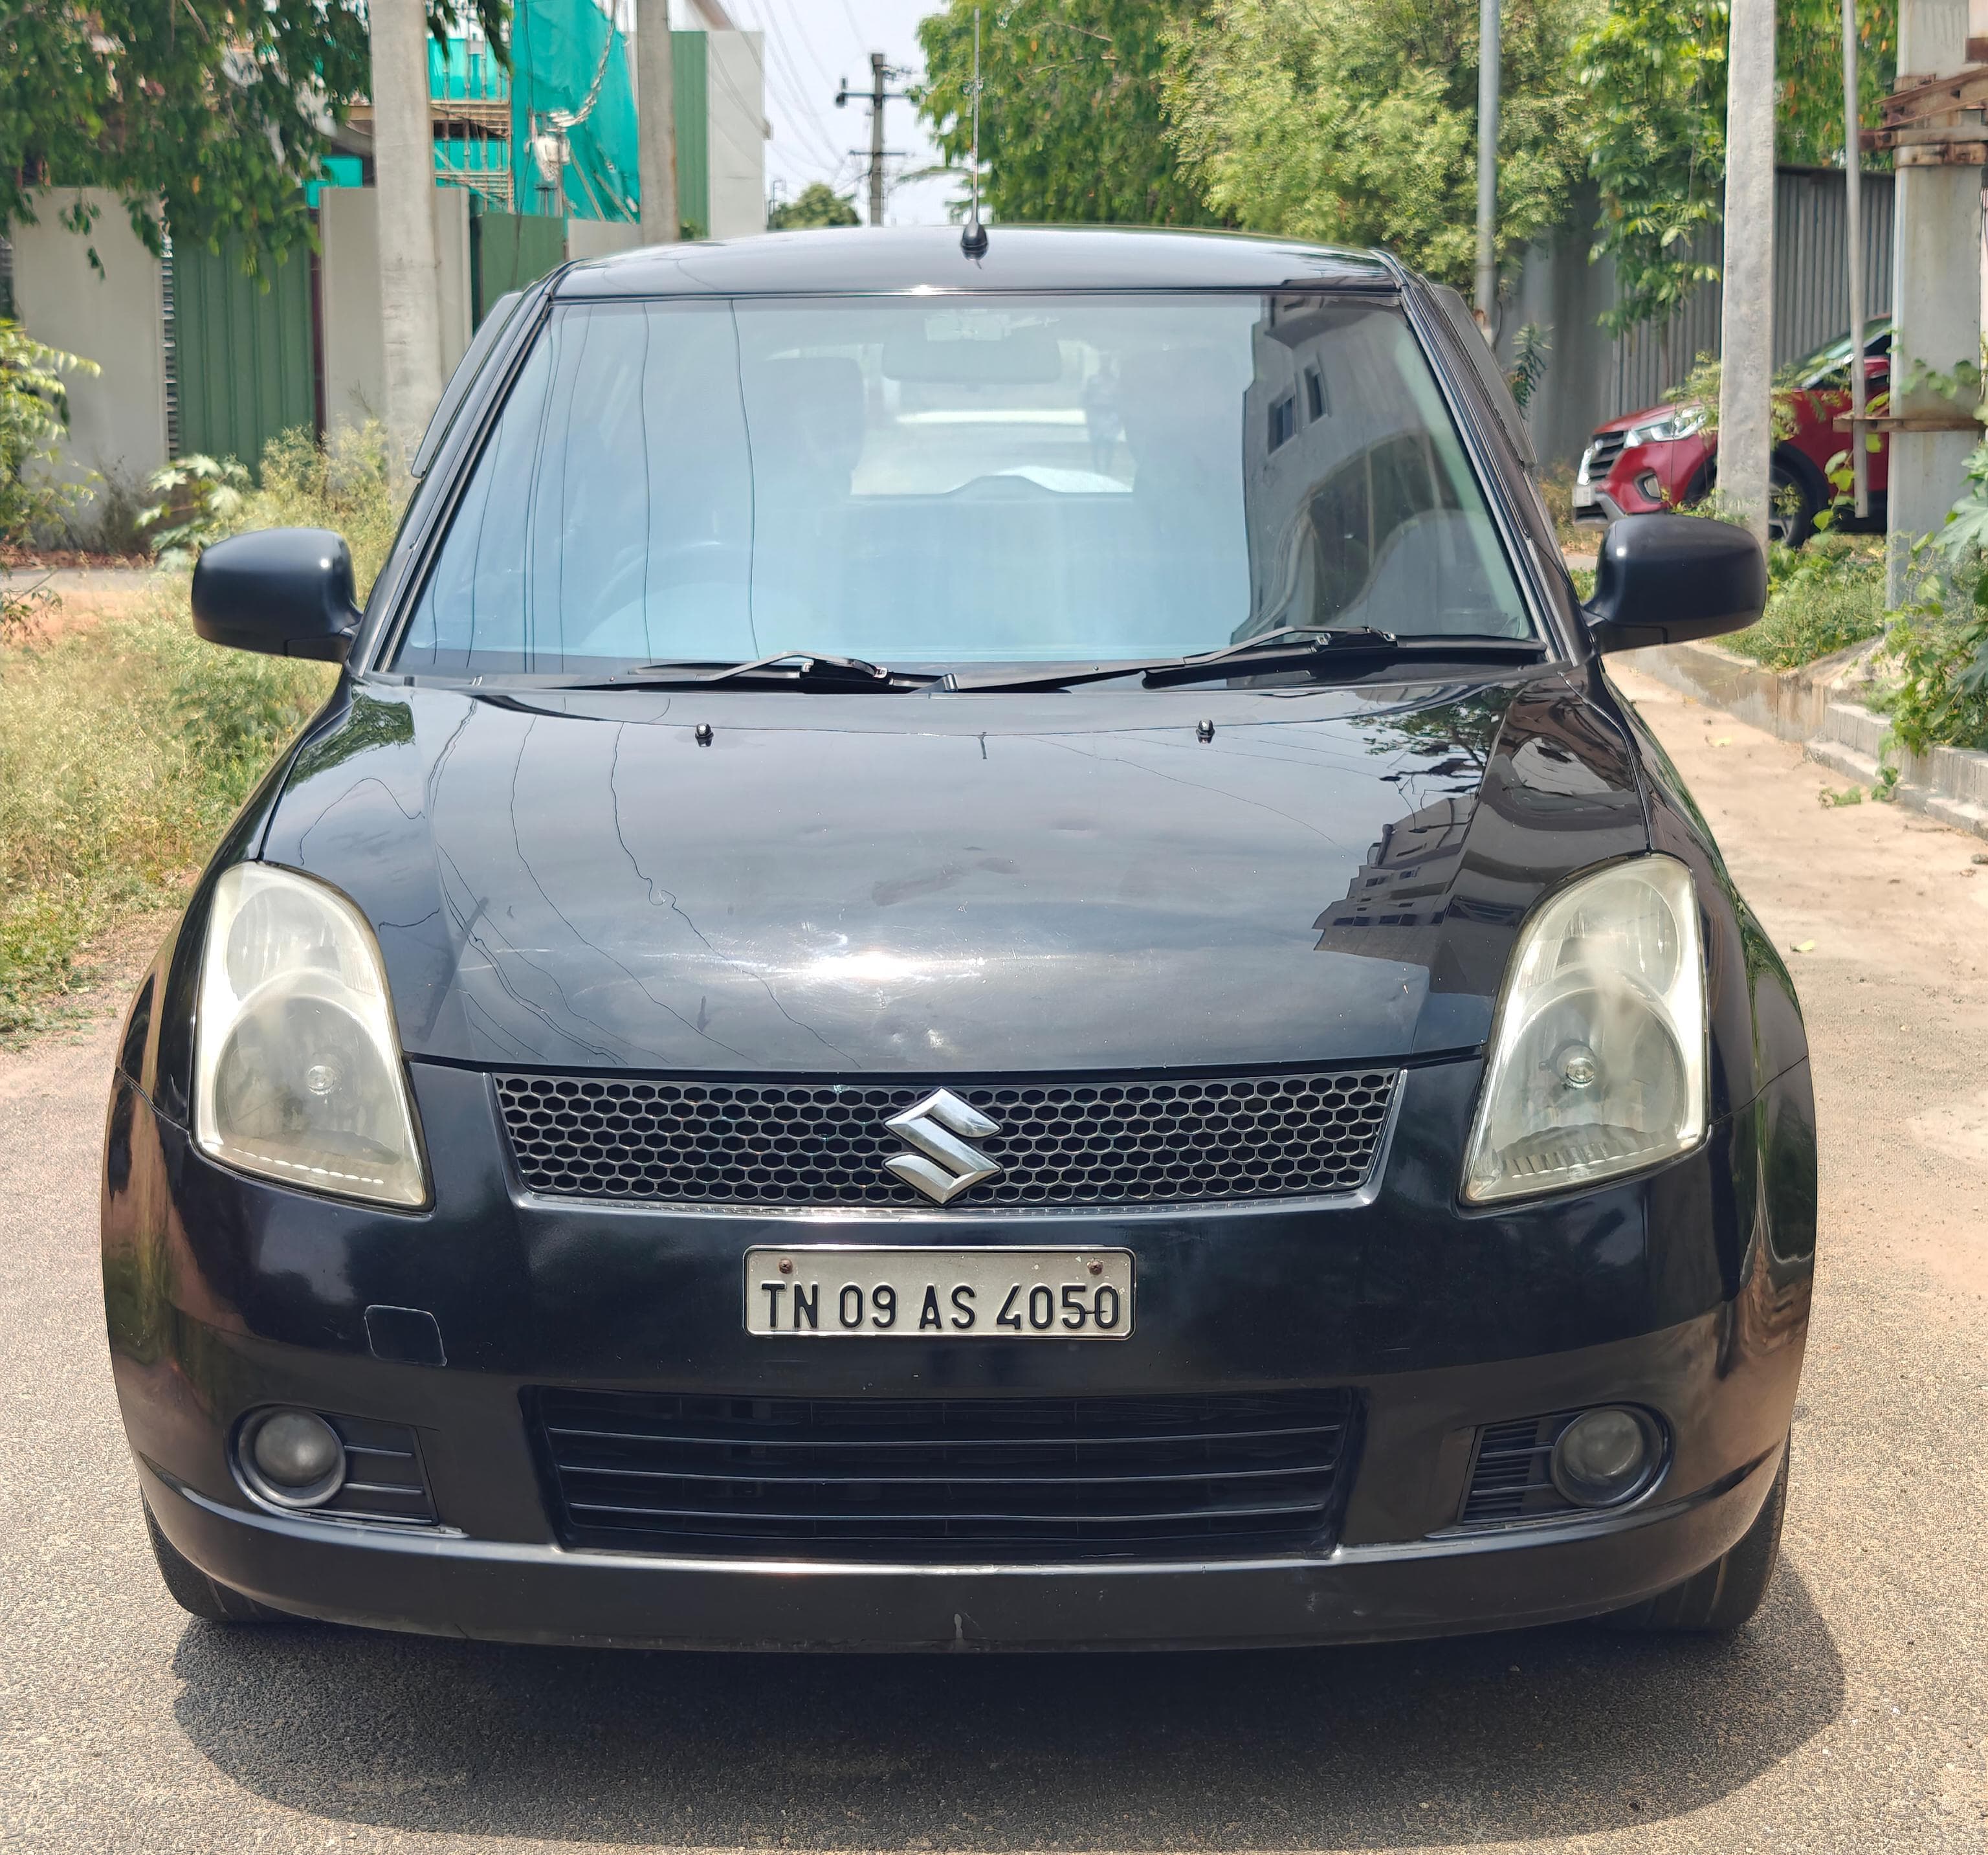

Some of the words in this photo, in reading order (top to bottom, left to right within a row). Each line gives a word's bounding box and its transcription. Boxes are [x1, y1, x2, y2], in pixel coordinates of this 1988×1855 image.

[761, 1283, 819, 1327] TN
[839, 1284, 896, 1328] 09
[919, 1285, 976, 1329] AS
[996, 1285, 1119, 1329] 4050
